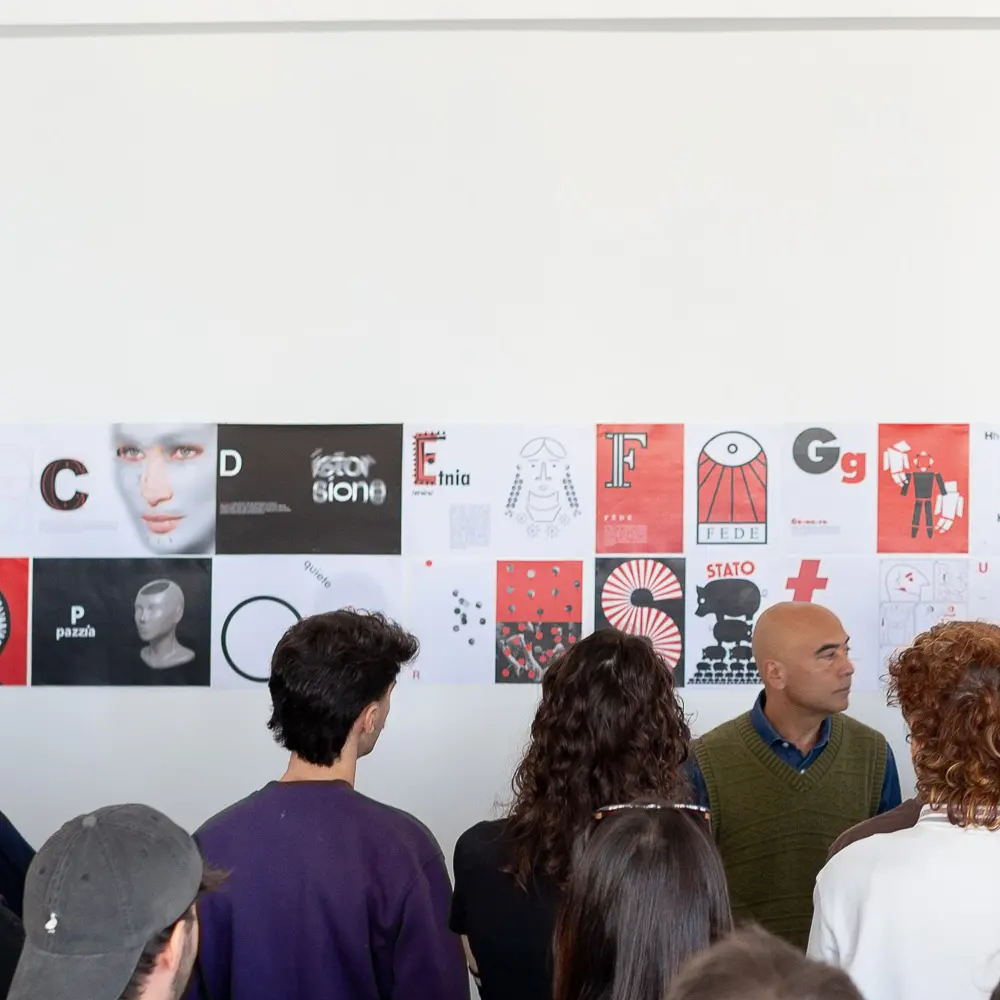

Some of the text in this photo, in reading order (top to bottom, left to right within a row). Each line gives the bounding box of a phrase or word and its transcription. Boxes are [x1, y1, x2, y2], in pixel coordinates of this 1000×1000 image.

[219, 449, 243, 477] D
[604, 432, 648, 489] F
[40, 458, 89, 511] C
[706, 527, 761, 540] FEDE
[303, 559, 332, 589] quiete
[706, 561, 755, 579] STATO
[979, 562, 988, 574] U
[71, 606, 85, 624] P
